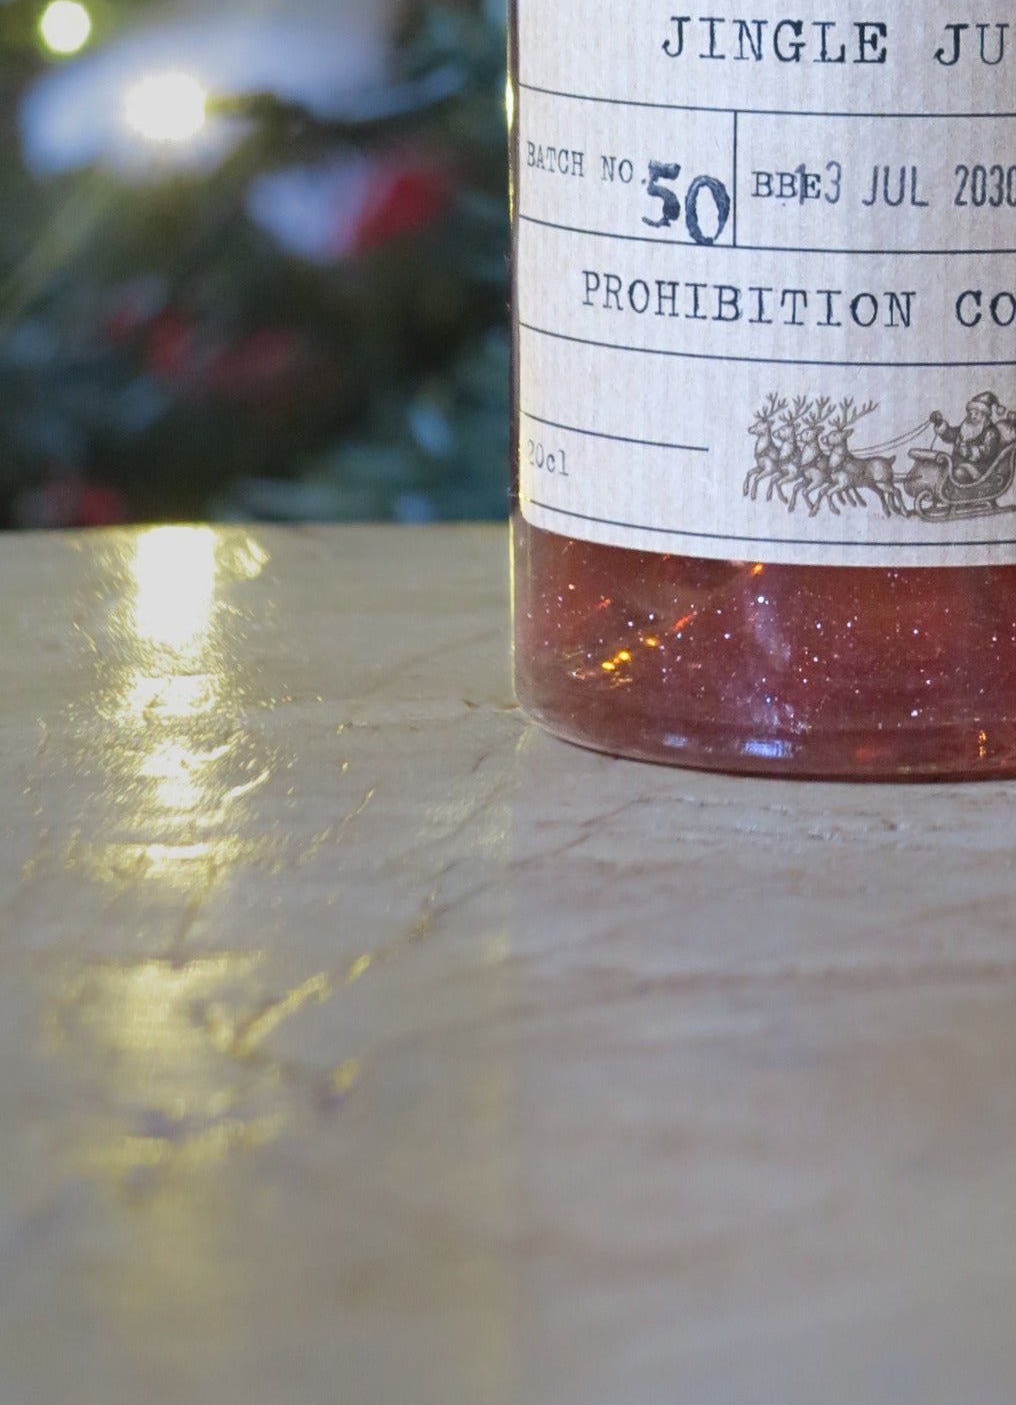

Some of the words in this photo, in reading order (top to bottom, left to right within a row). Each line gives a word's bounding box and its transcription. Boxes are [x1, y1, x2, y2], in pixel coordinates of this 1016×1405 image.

[661, 15, 889, 64] JINGLE
[525, 141, 586, 178] BATCH
[641, 159, 731, 245] 50
[751, 170, 822, 200] BBE
[861, 164, 930, 208] JUL
[581, 269, 917, 329] PROHIBITION
